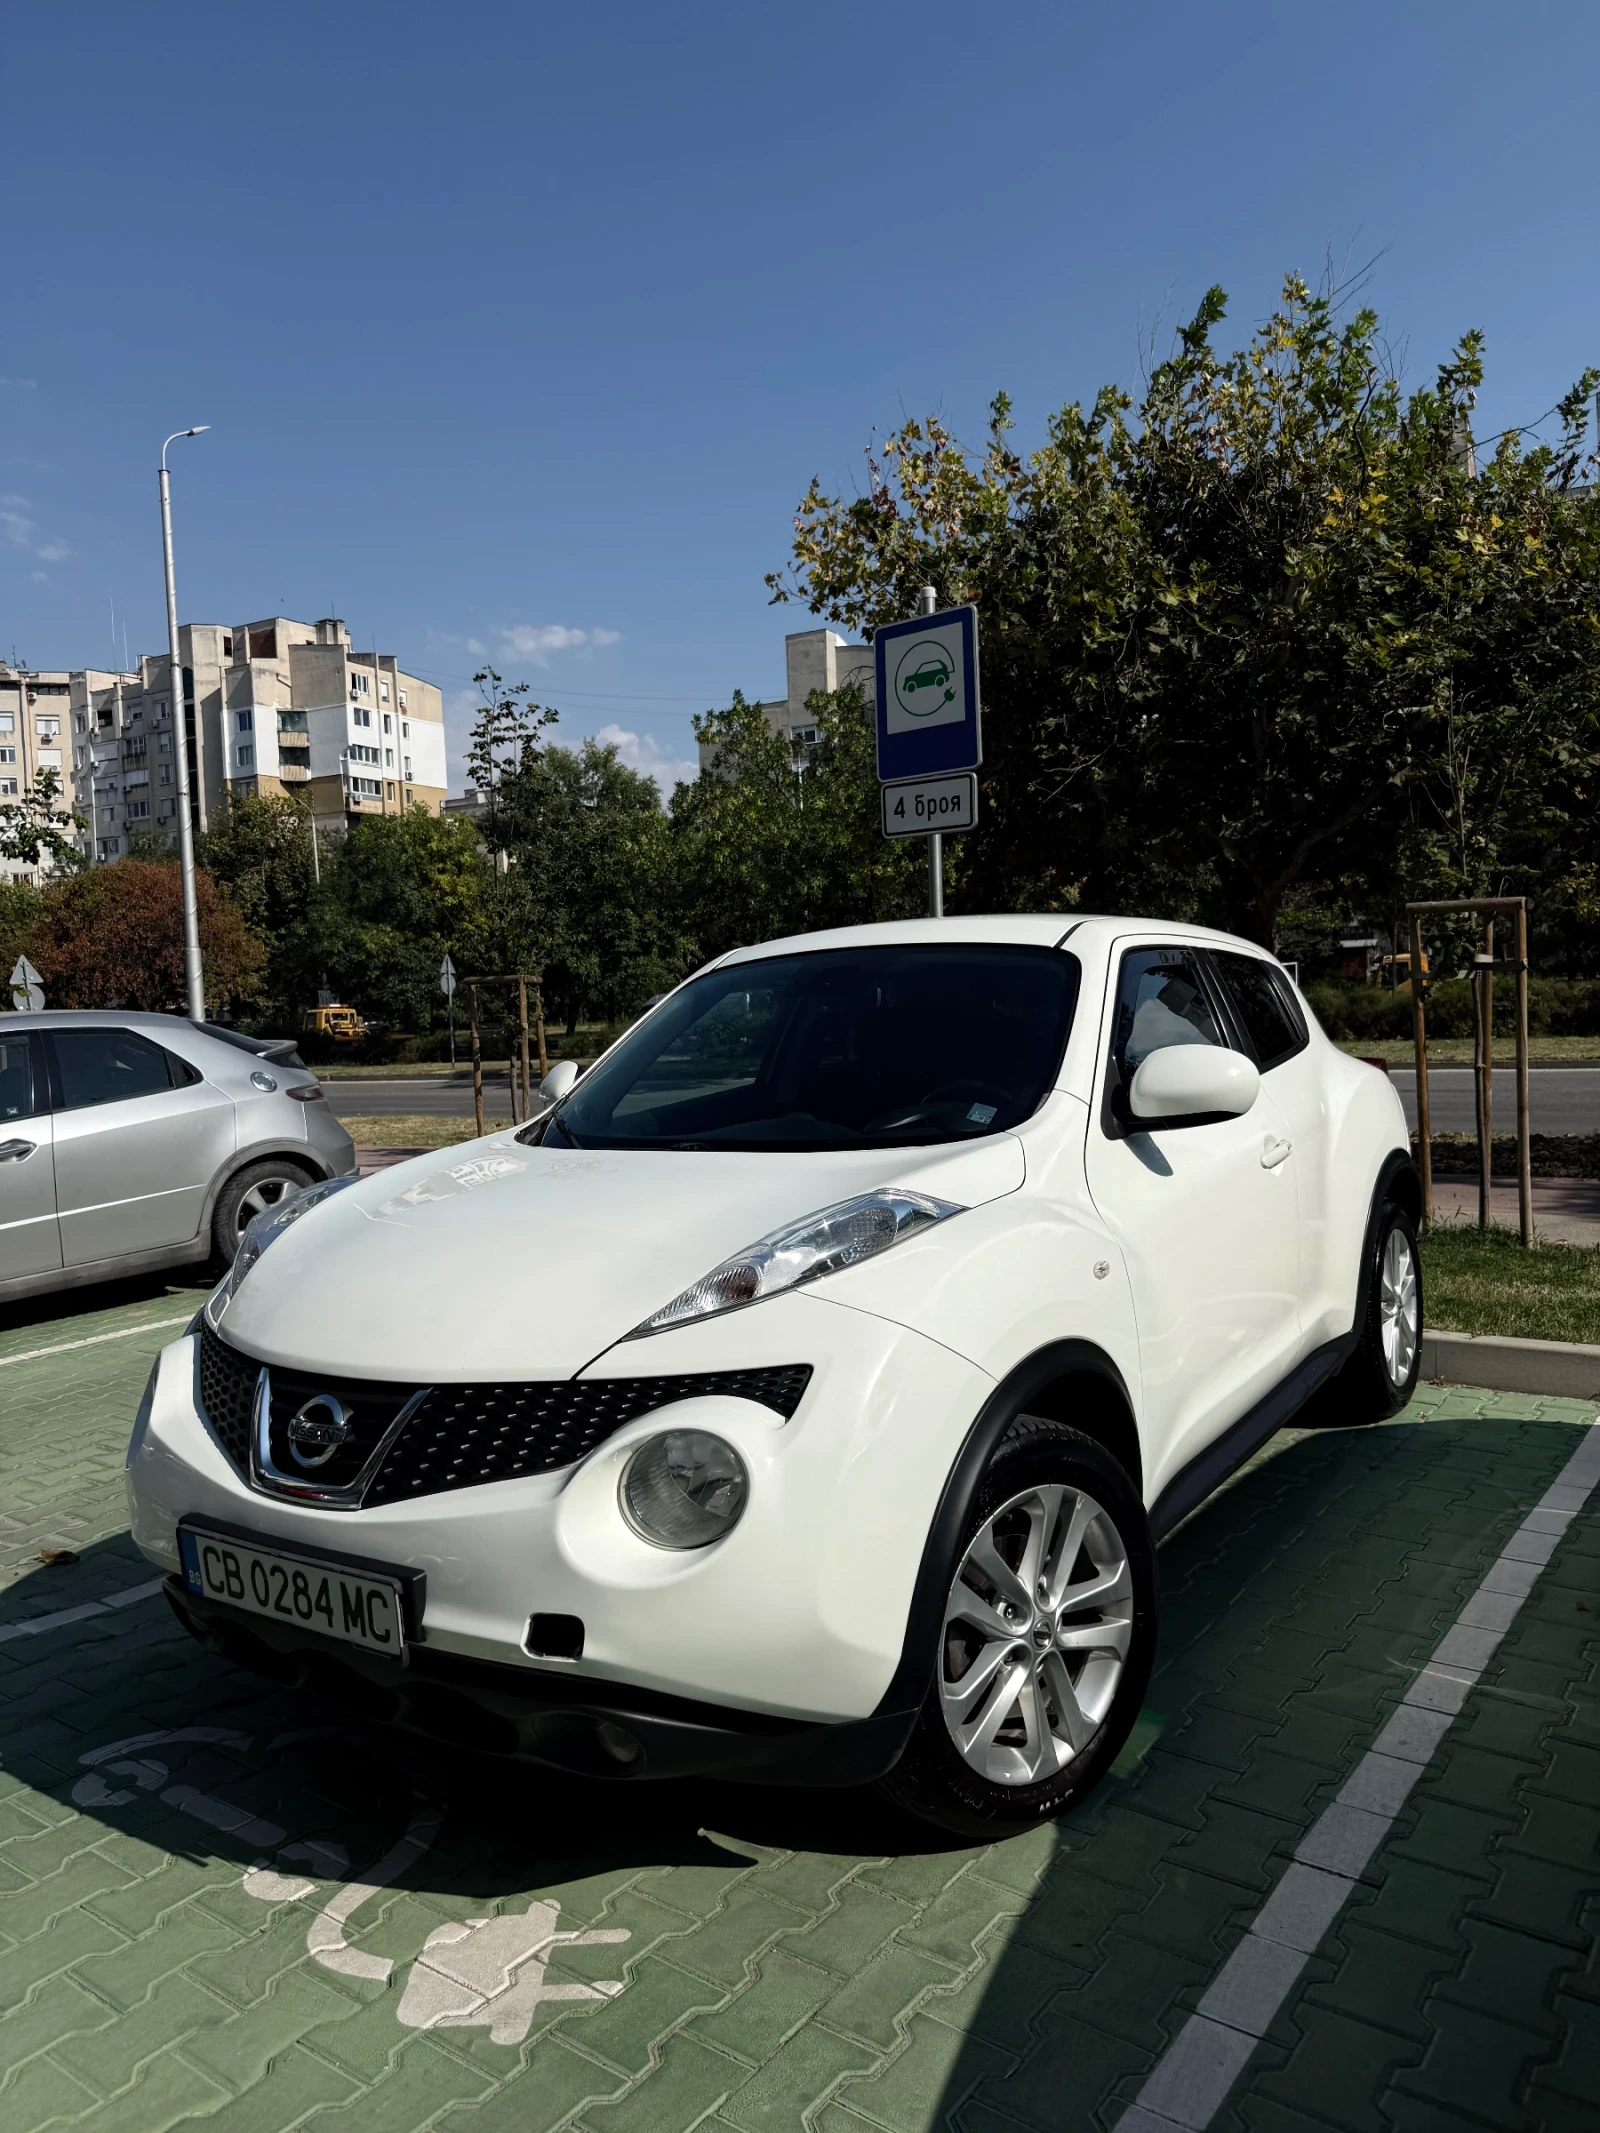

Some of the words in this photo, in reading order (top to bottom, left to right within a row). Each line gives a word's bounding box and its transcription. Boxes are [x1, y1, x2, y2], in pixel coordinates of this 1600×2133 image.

[894, 796, 906, 819] 4
[914, 794, 961, 822] броя
[188, 1568, 202, 1586] BG
